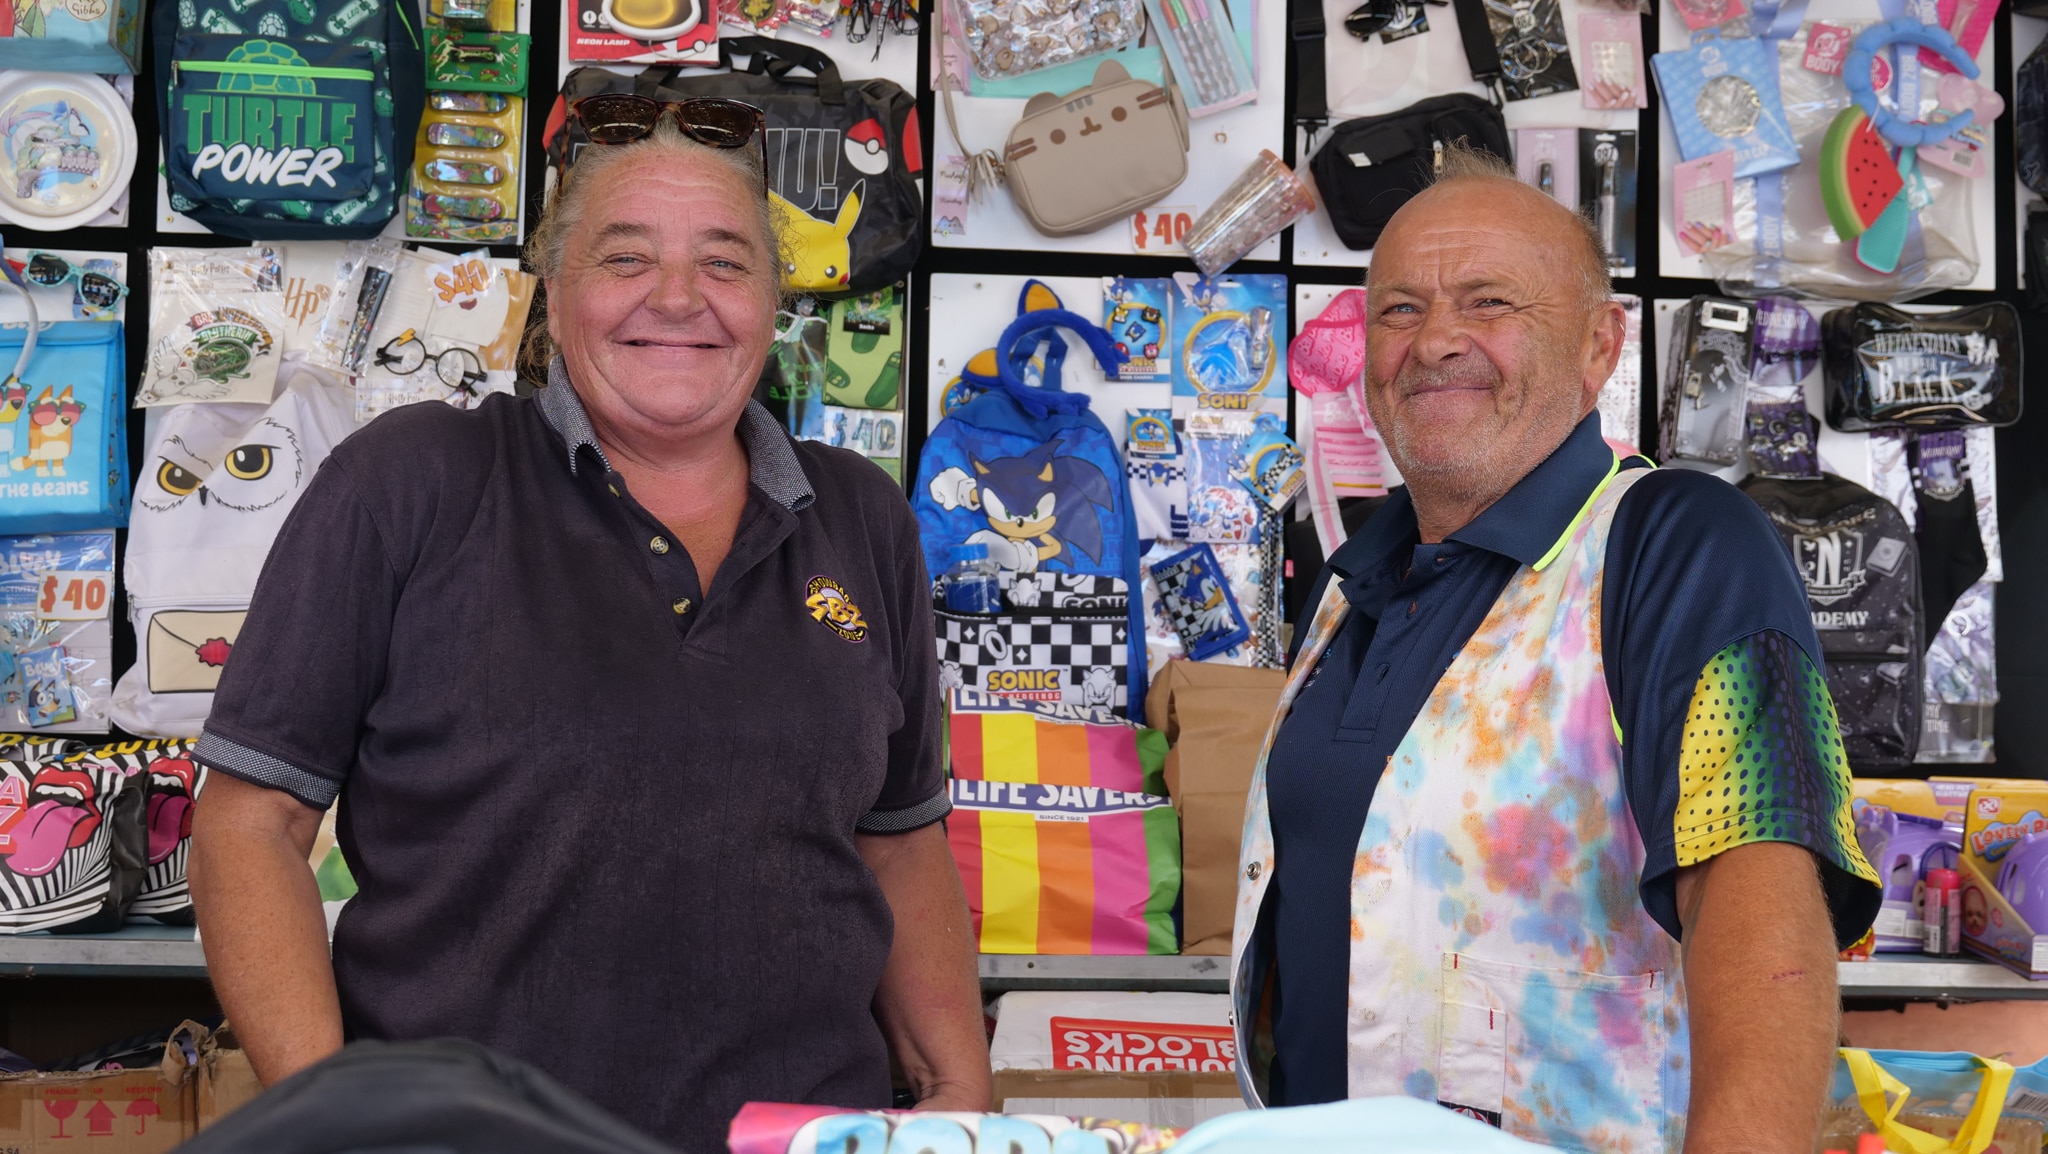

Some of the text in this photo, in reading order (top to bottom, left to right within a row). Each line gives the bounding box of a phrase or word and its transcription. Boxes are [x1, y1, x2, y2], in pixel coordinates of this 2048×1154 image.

[1805, 54, 1840, 73] BODY
[183, 94, 356, 163] TURTLE
[191, 143, 344, 188] POWER
[1134, 210, 1194, 249] $40
[434, 258, 491, 303] $40
[1878, 361, 1960, 405] BLACK
[40, 575, 106, 612] $40
[806, 592, 868, 630] SBZ
[1811, 611, 1869, 625] ADEMY
[986, 669, 1060, 691] SONIC
[1008, 691, 1062, 700] HEDGEHOG
[959, 780, 1163, 808] LIFE SAVERS
[1973, 823, 2029, 852] LOVELY
[1063, 1030, 1235, 1062] BLOCKS
[45, 1086, 79, 1095] FRAGILE
